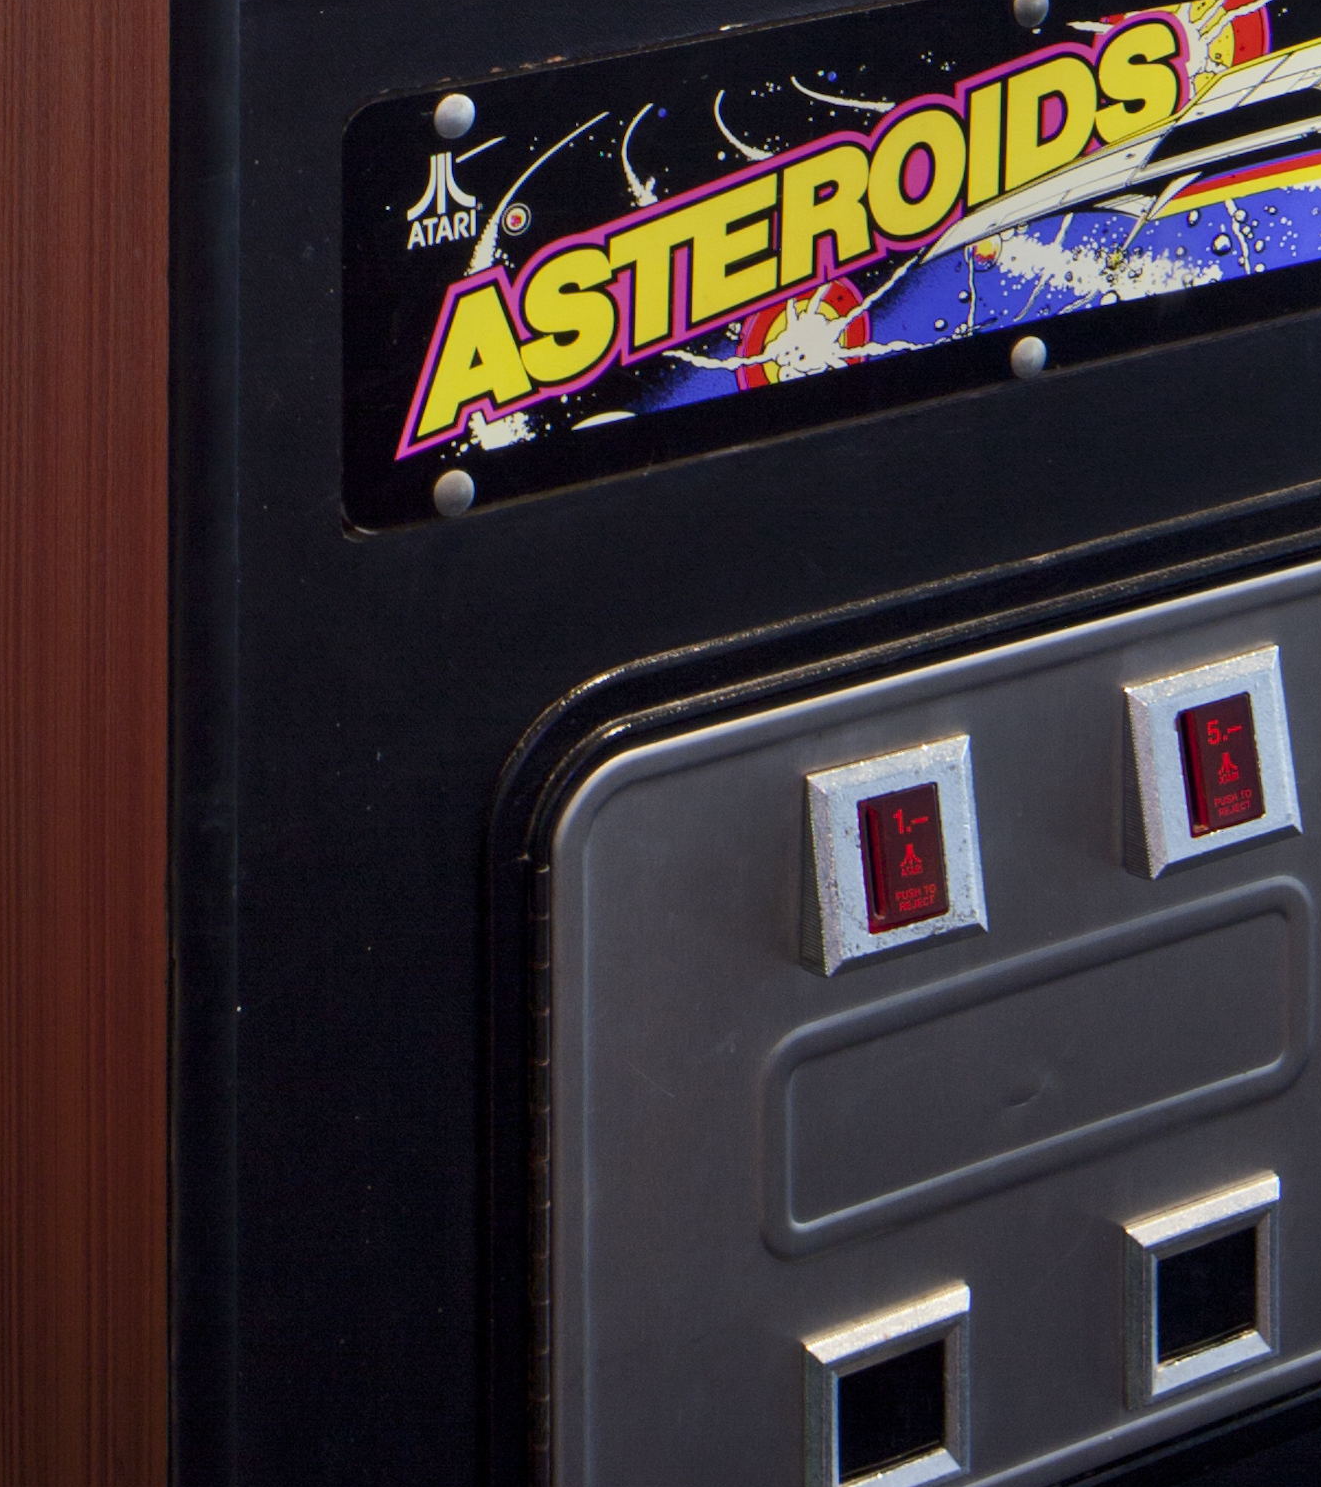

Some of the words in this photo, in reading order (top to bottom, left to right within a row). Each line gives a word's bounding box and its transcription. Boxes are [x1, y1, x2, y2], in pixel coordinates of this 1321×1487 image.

[404, 18, 1187, 453] ASTEROIDS
[407, 208, 476, 250] ATARI
[1214, 793, 1238, 808] PUSH
[1240, 788, 1253, 799] TO
[1219, 800, 1252, 817] REJECT
[895, 888, 922, 902] PUSH
[924, 883, 937, 895] TO
[899, 895, 935, 912] REJECT
